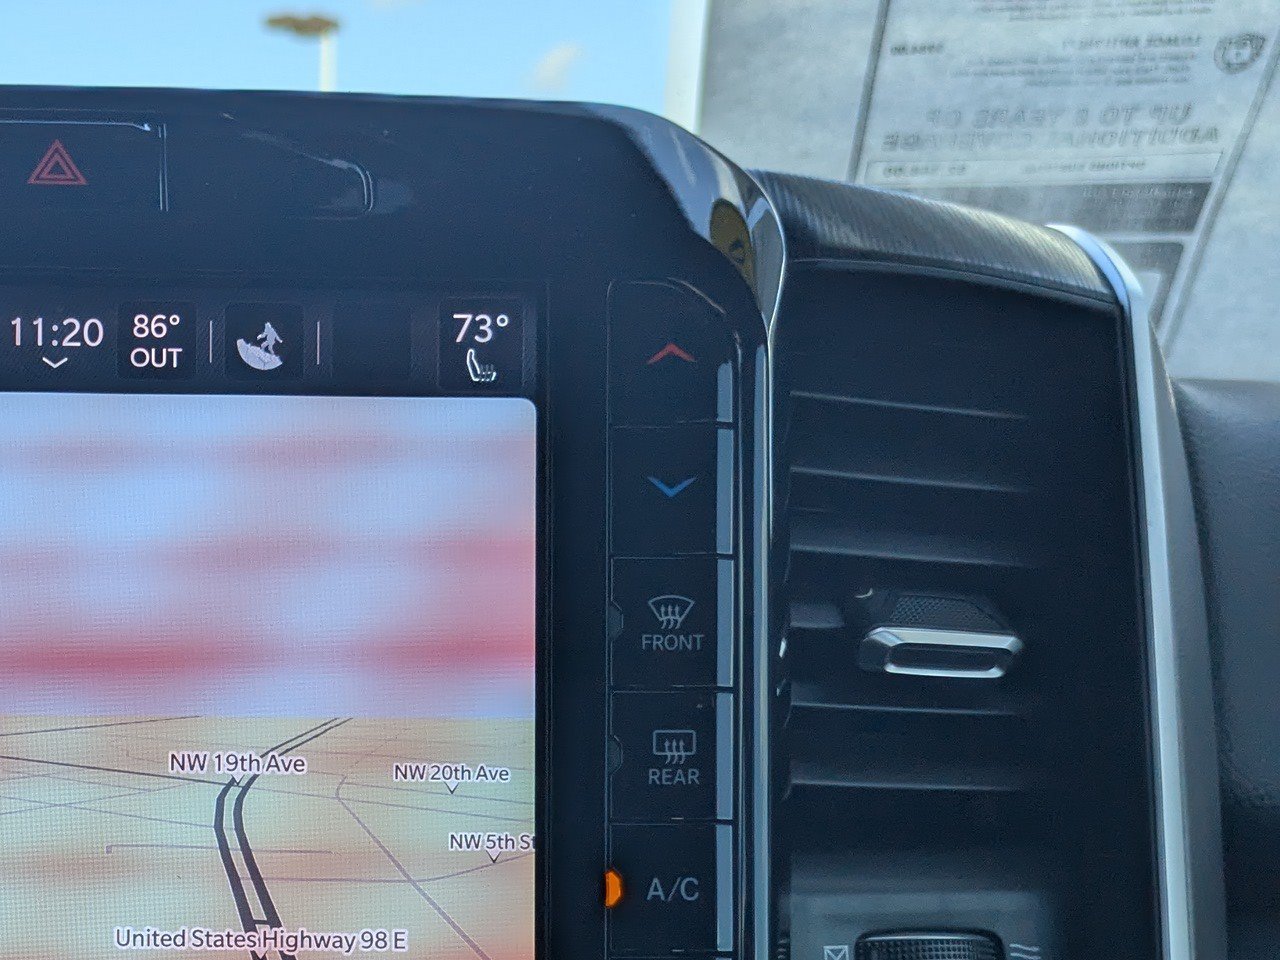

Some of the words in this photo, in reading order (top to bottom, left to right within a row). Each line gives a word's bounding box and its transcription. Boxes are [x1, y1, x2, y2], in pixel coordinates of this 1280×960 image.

[11, 317, 104, 347] 11:20
[133, 314, 180, 338] 86°
[452, 311, 509, 342] 73°
[130, 348, 183, 368] OUT
[641, 634, 704, 651] FRONT
[170, 753, 207, 771] NW
[215, 753, 260, 772] 19th
[265, 754, 305, 772] Ave
[395, 764, 426, 780] NW
[431, 765, 471, 781] 20th
[476, 765, 509, 781] Ave
[648, 769, 700, 784] REAR
[450, 834, 480, 849] NW
[486, 834, 515, 850] 5th
[646, 877, 700, 901] A/C
[116, 929, 186, 947] United
[191, 930, 257, 948] States
[263, 930, 356, 953] Highway
[361, 931, 388, 949] 98
[394, 931, 406, 949] E
